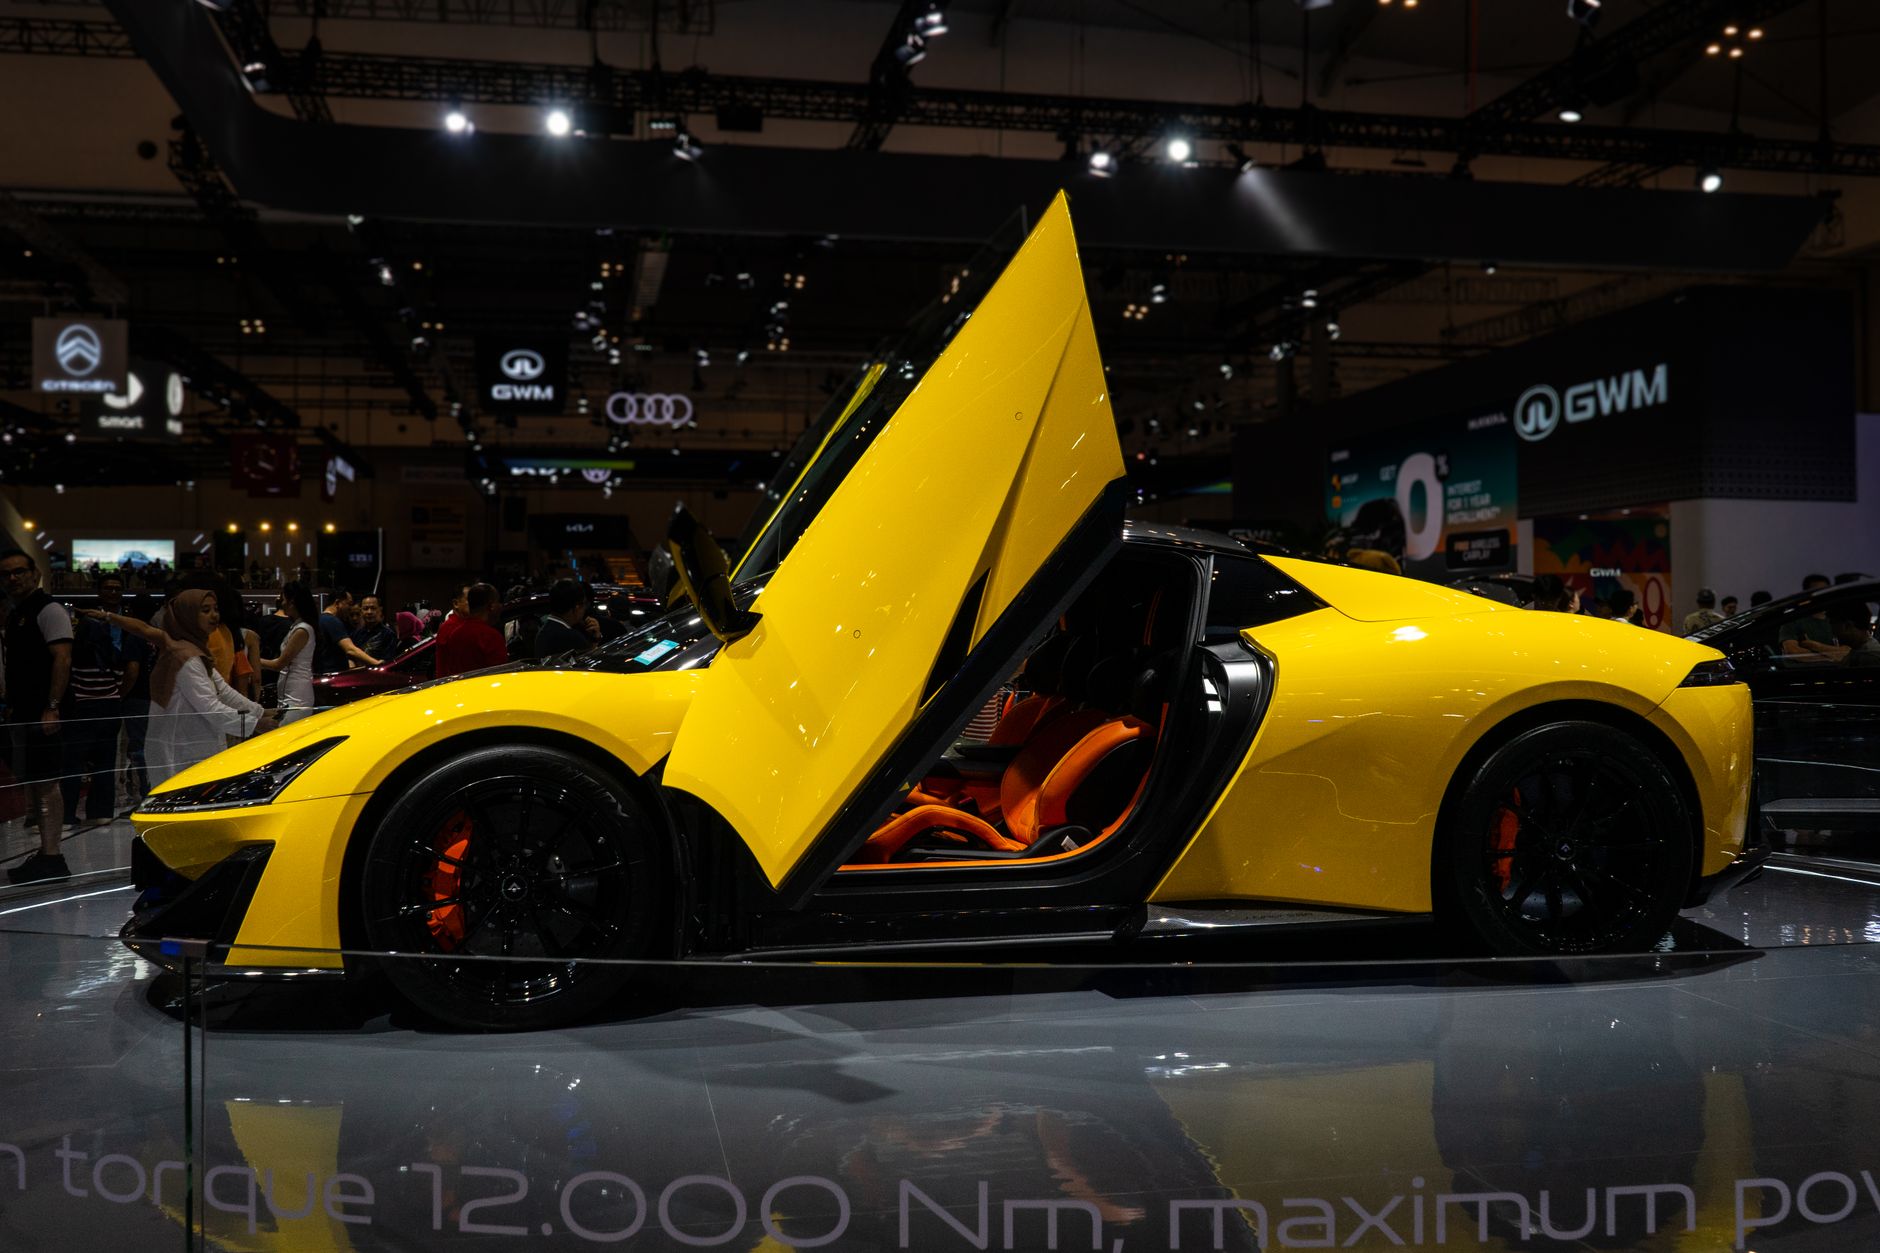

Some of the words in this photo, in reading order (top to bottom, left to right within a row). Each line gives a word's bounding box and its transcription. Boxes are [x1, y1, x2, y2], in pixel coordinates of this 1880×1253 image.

[490, 384, 555, 401] GWM
[1563, 363, 1669, 424] GWM
[97, 415, 145, 429] smart
[1589, 568, 1621, 577] GWM
[55, 1134, 376, 1234] torque
[411, 1162, 851, 1248] 12.000
[1169, 1176, 1697, 1251] maximum
